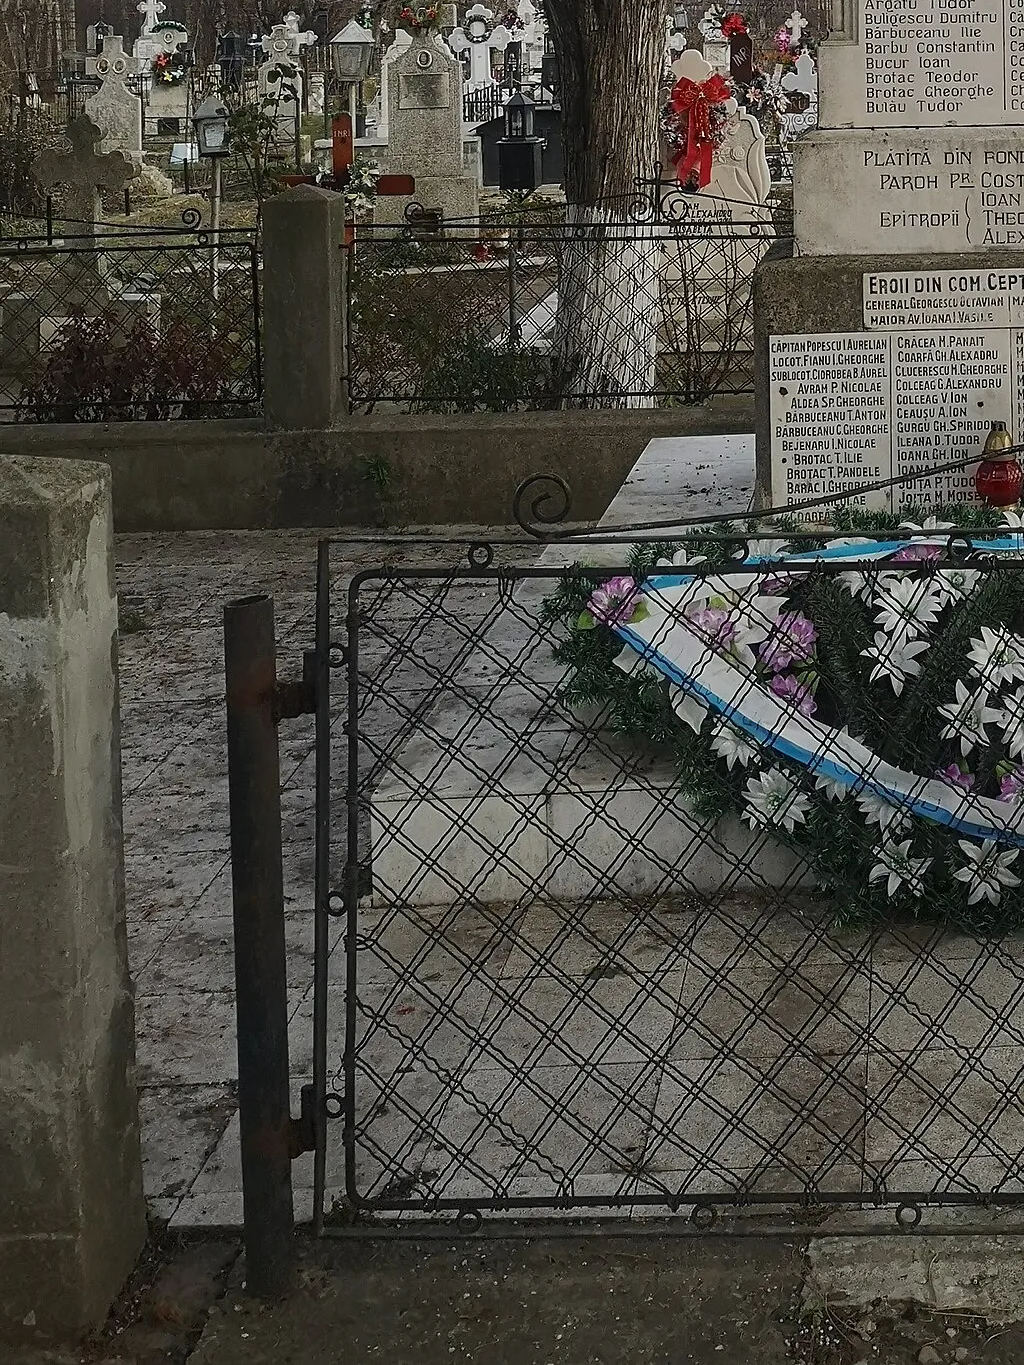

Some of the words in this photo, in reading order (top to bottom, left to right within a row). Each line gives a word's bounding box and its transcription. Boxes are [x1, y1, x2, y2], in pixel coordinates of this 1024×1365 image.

[864, 12, 934, 27] Buligescu
[939, 11, 998, 24] Dumitru
[961, 26, 982, 38] Ilie
[865, 41, 908, 55] Barbu
[916, 41, 995, 54] Constantin
[866, 57, 910, 70] Bucur
[919, 56, 951, 69] Ioan
[866, 72, 915, 84] Brotac
[925, 70, 979, 83] Teodor
[866, 86, 915, 99] Brotac
[924, 84, 994, 100] Gheorghe
[916, 99, 963, 112] Tudor
[943, 149, 972, 165] DIN
[879, 174, 938, 191] PAROH
[981, 190, 1021, 207] IOAN
[869, 275, 909, 295] EROII
[914, 276, 942, 294] DIN
[865, 298, 910, 311] GENERAL
[870, 314, 906, 325] MAIOR
